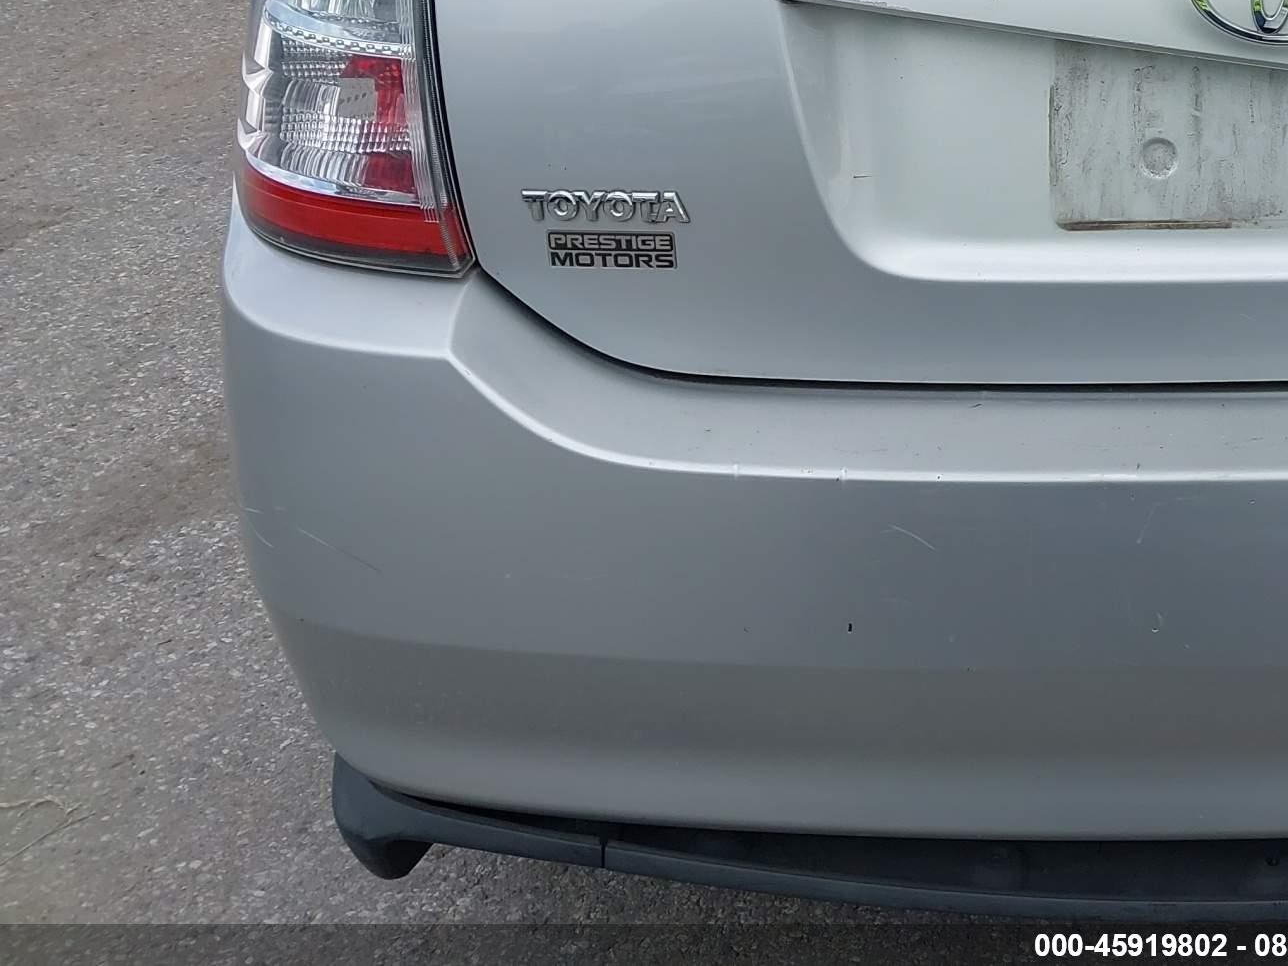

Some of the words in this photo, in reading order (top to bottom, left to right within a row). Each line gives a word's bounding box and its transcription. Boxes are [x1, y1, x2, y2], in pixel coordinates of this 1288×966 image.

[520, 189, 691, 224] TOYOTA
[549, 233, 673, 251] PRESTIGE
[550, 251, 674, 269] MOTORS
